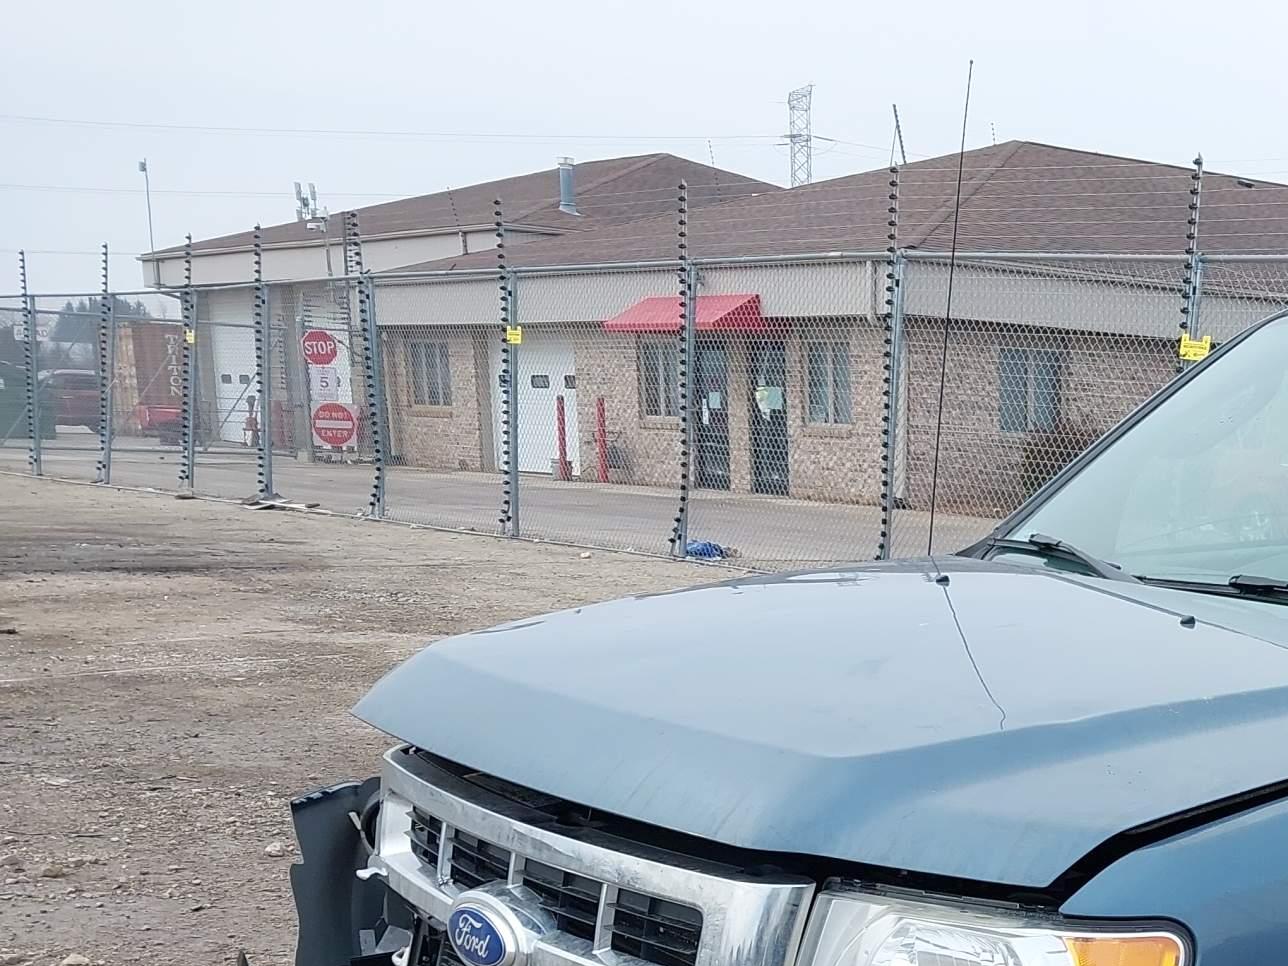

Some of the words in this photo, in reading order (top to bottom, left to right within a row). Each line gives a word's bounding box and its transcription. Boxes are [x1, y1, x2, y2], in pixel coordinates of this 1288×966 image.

[304, 340, 335, 355] STOP
[319, 376, 329, 388] 5
[321, 429, 349, 437] ENTER
[454, 913, 491, 958] Ford
